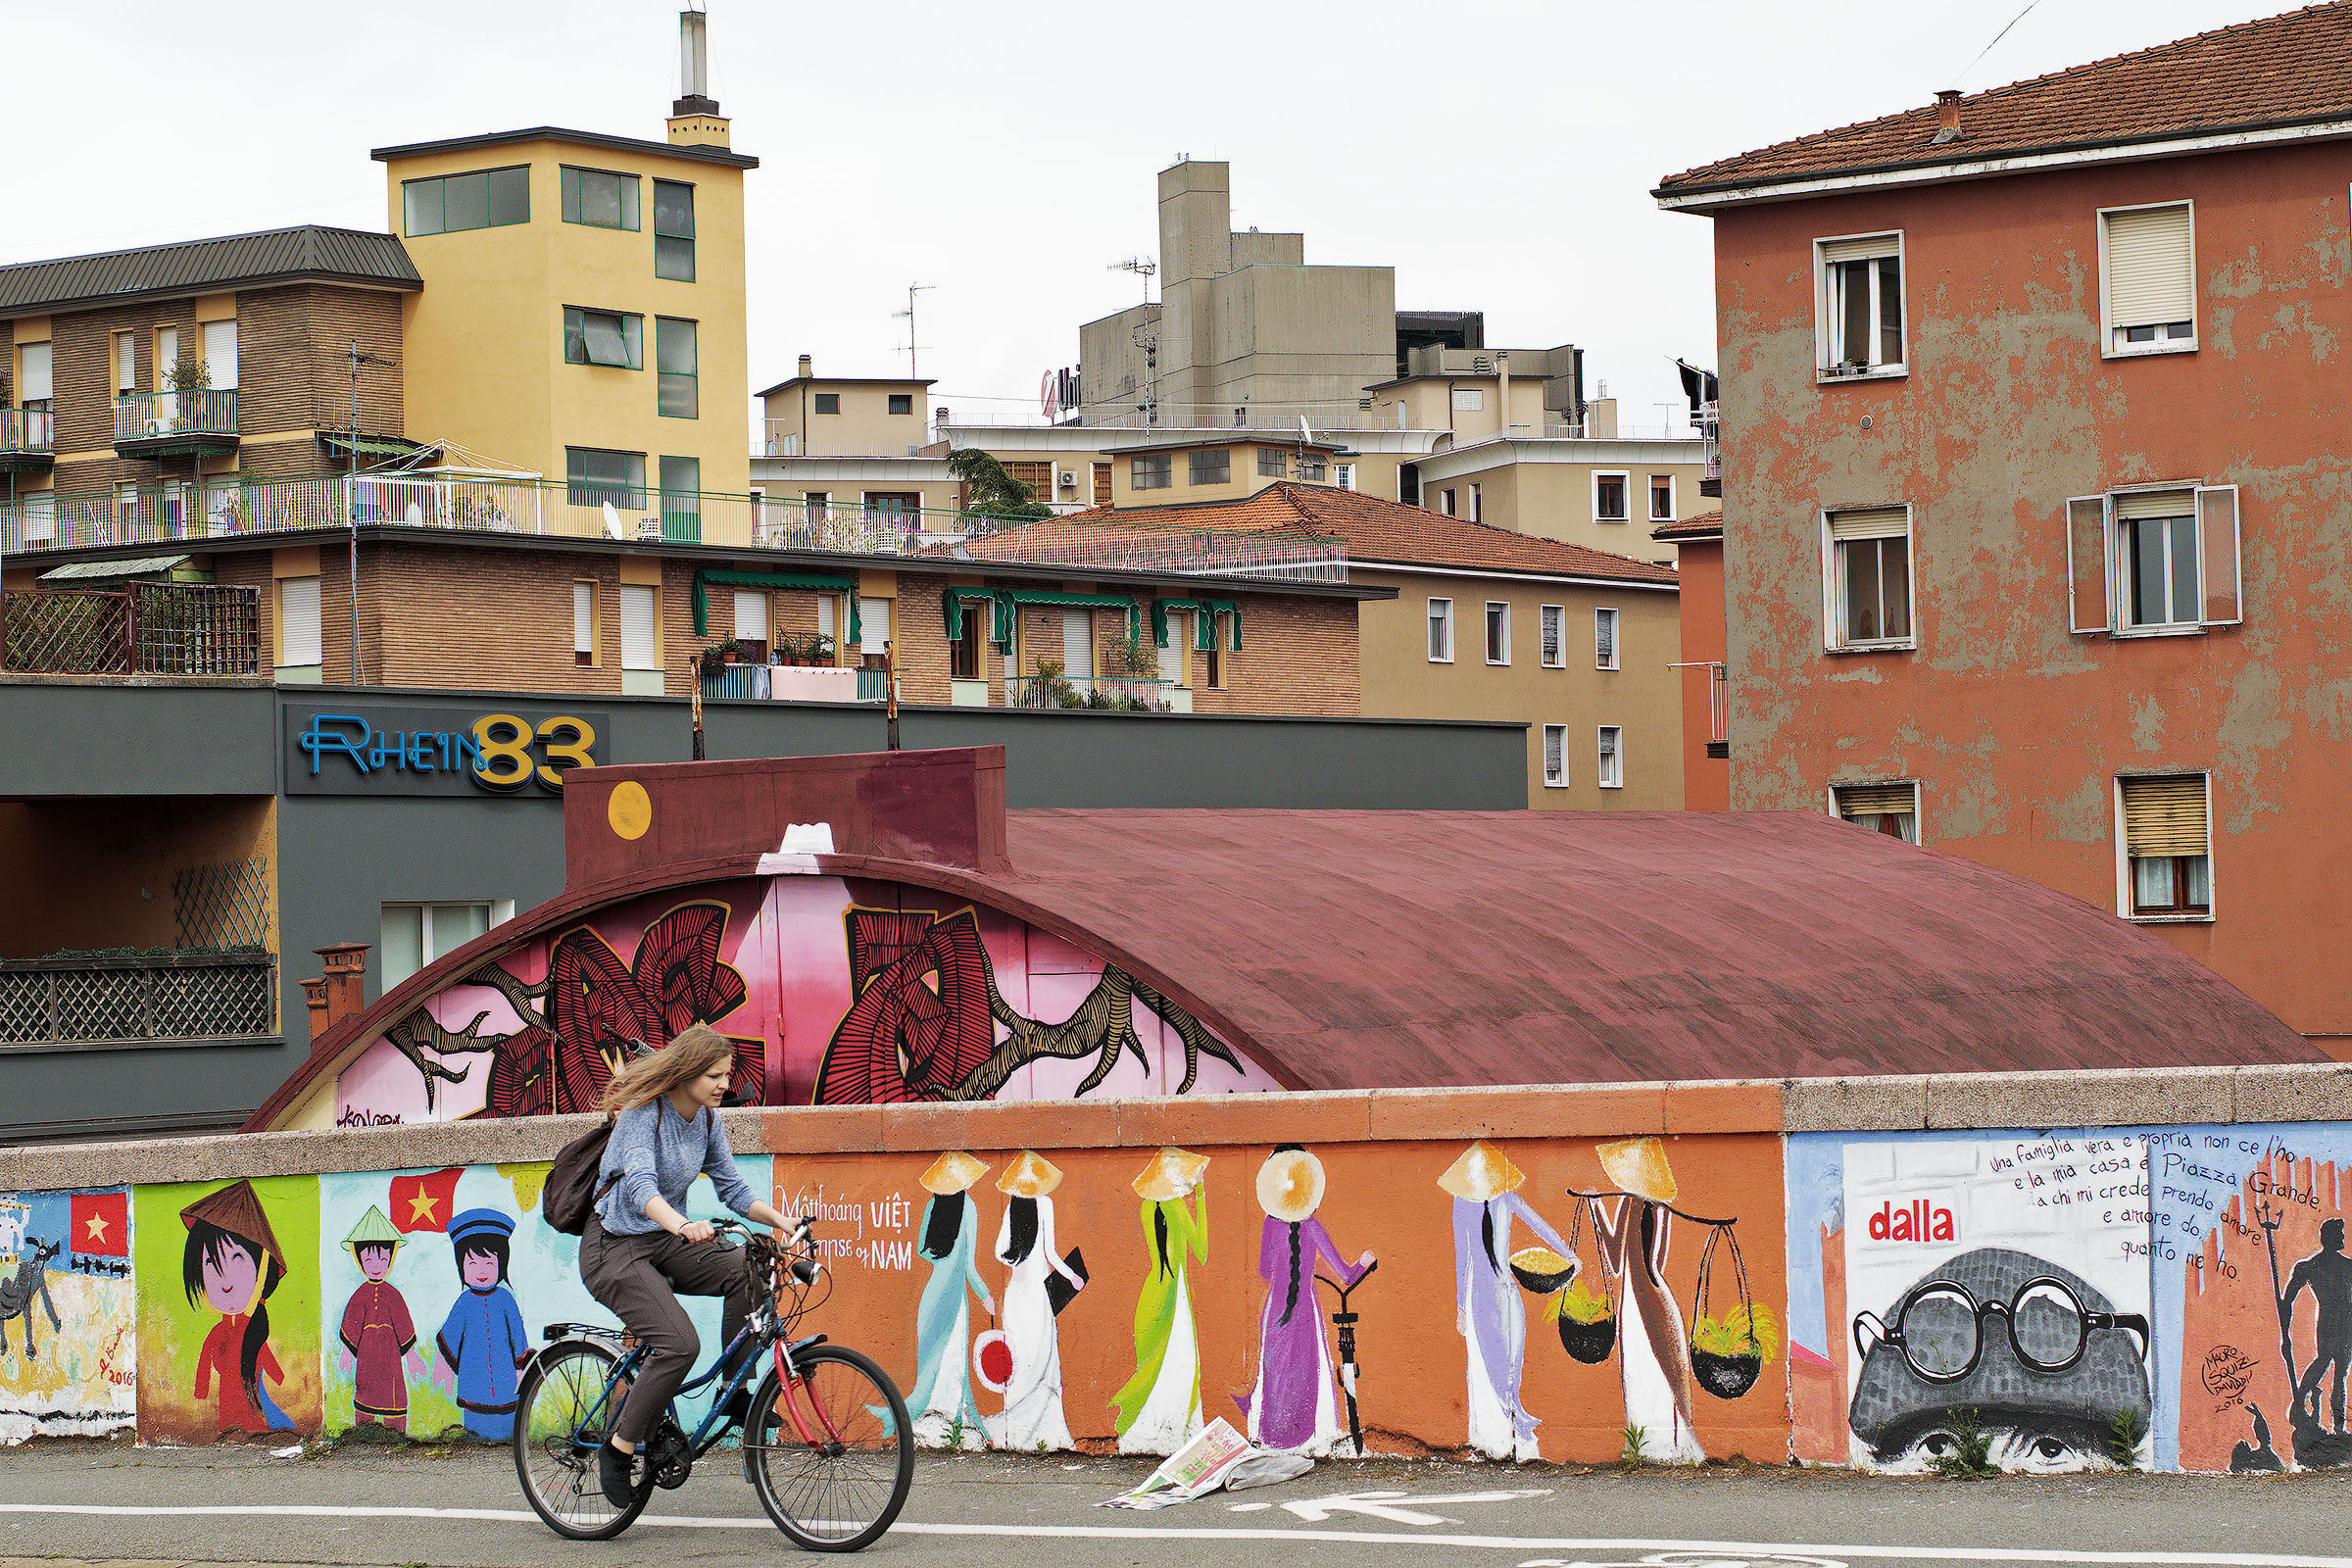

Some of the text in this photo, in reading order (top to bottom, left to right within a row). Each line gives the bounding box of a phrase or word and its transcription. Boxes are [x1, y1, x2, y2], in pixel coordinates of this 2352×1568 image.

[1989, 1156, 2014, 1173] Una
[2016, 1135, 2075, 1164] famiglia
[2084, 1140, 2115, 1155] vera
[2123, 1136, 2132, 1148] e
[2138, 1132, 2192, 1151] propria
[2204, 1135, 2230, 1149] non
[2014, 1177, 2024, 1190] e
[2027, 1170, 2045, 1189] la
[2052, 1164, 2078, 1184] mia
[2089, 1157, 2132, 1175] casa
[2162, 1152, 2237, 1187] Piazza
[1869, 1199, 1954, 1243] dalla
[2037, 1174, 2262, 1247] a chi mi crede prendo amore
[2103, 1210, 2113, 1224] e
[2120, 1208, 2172, 1226] amore
[871, 1239, 912, 1271] NAM
[2121, 1235, 2177, 1263] quanto
[2185, 1251, 2204, 1269] ne
[108, 1369, 133, 1387] 2016
[2215, 1394, 2244, 1414] 2016
